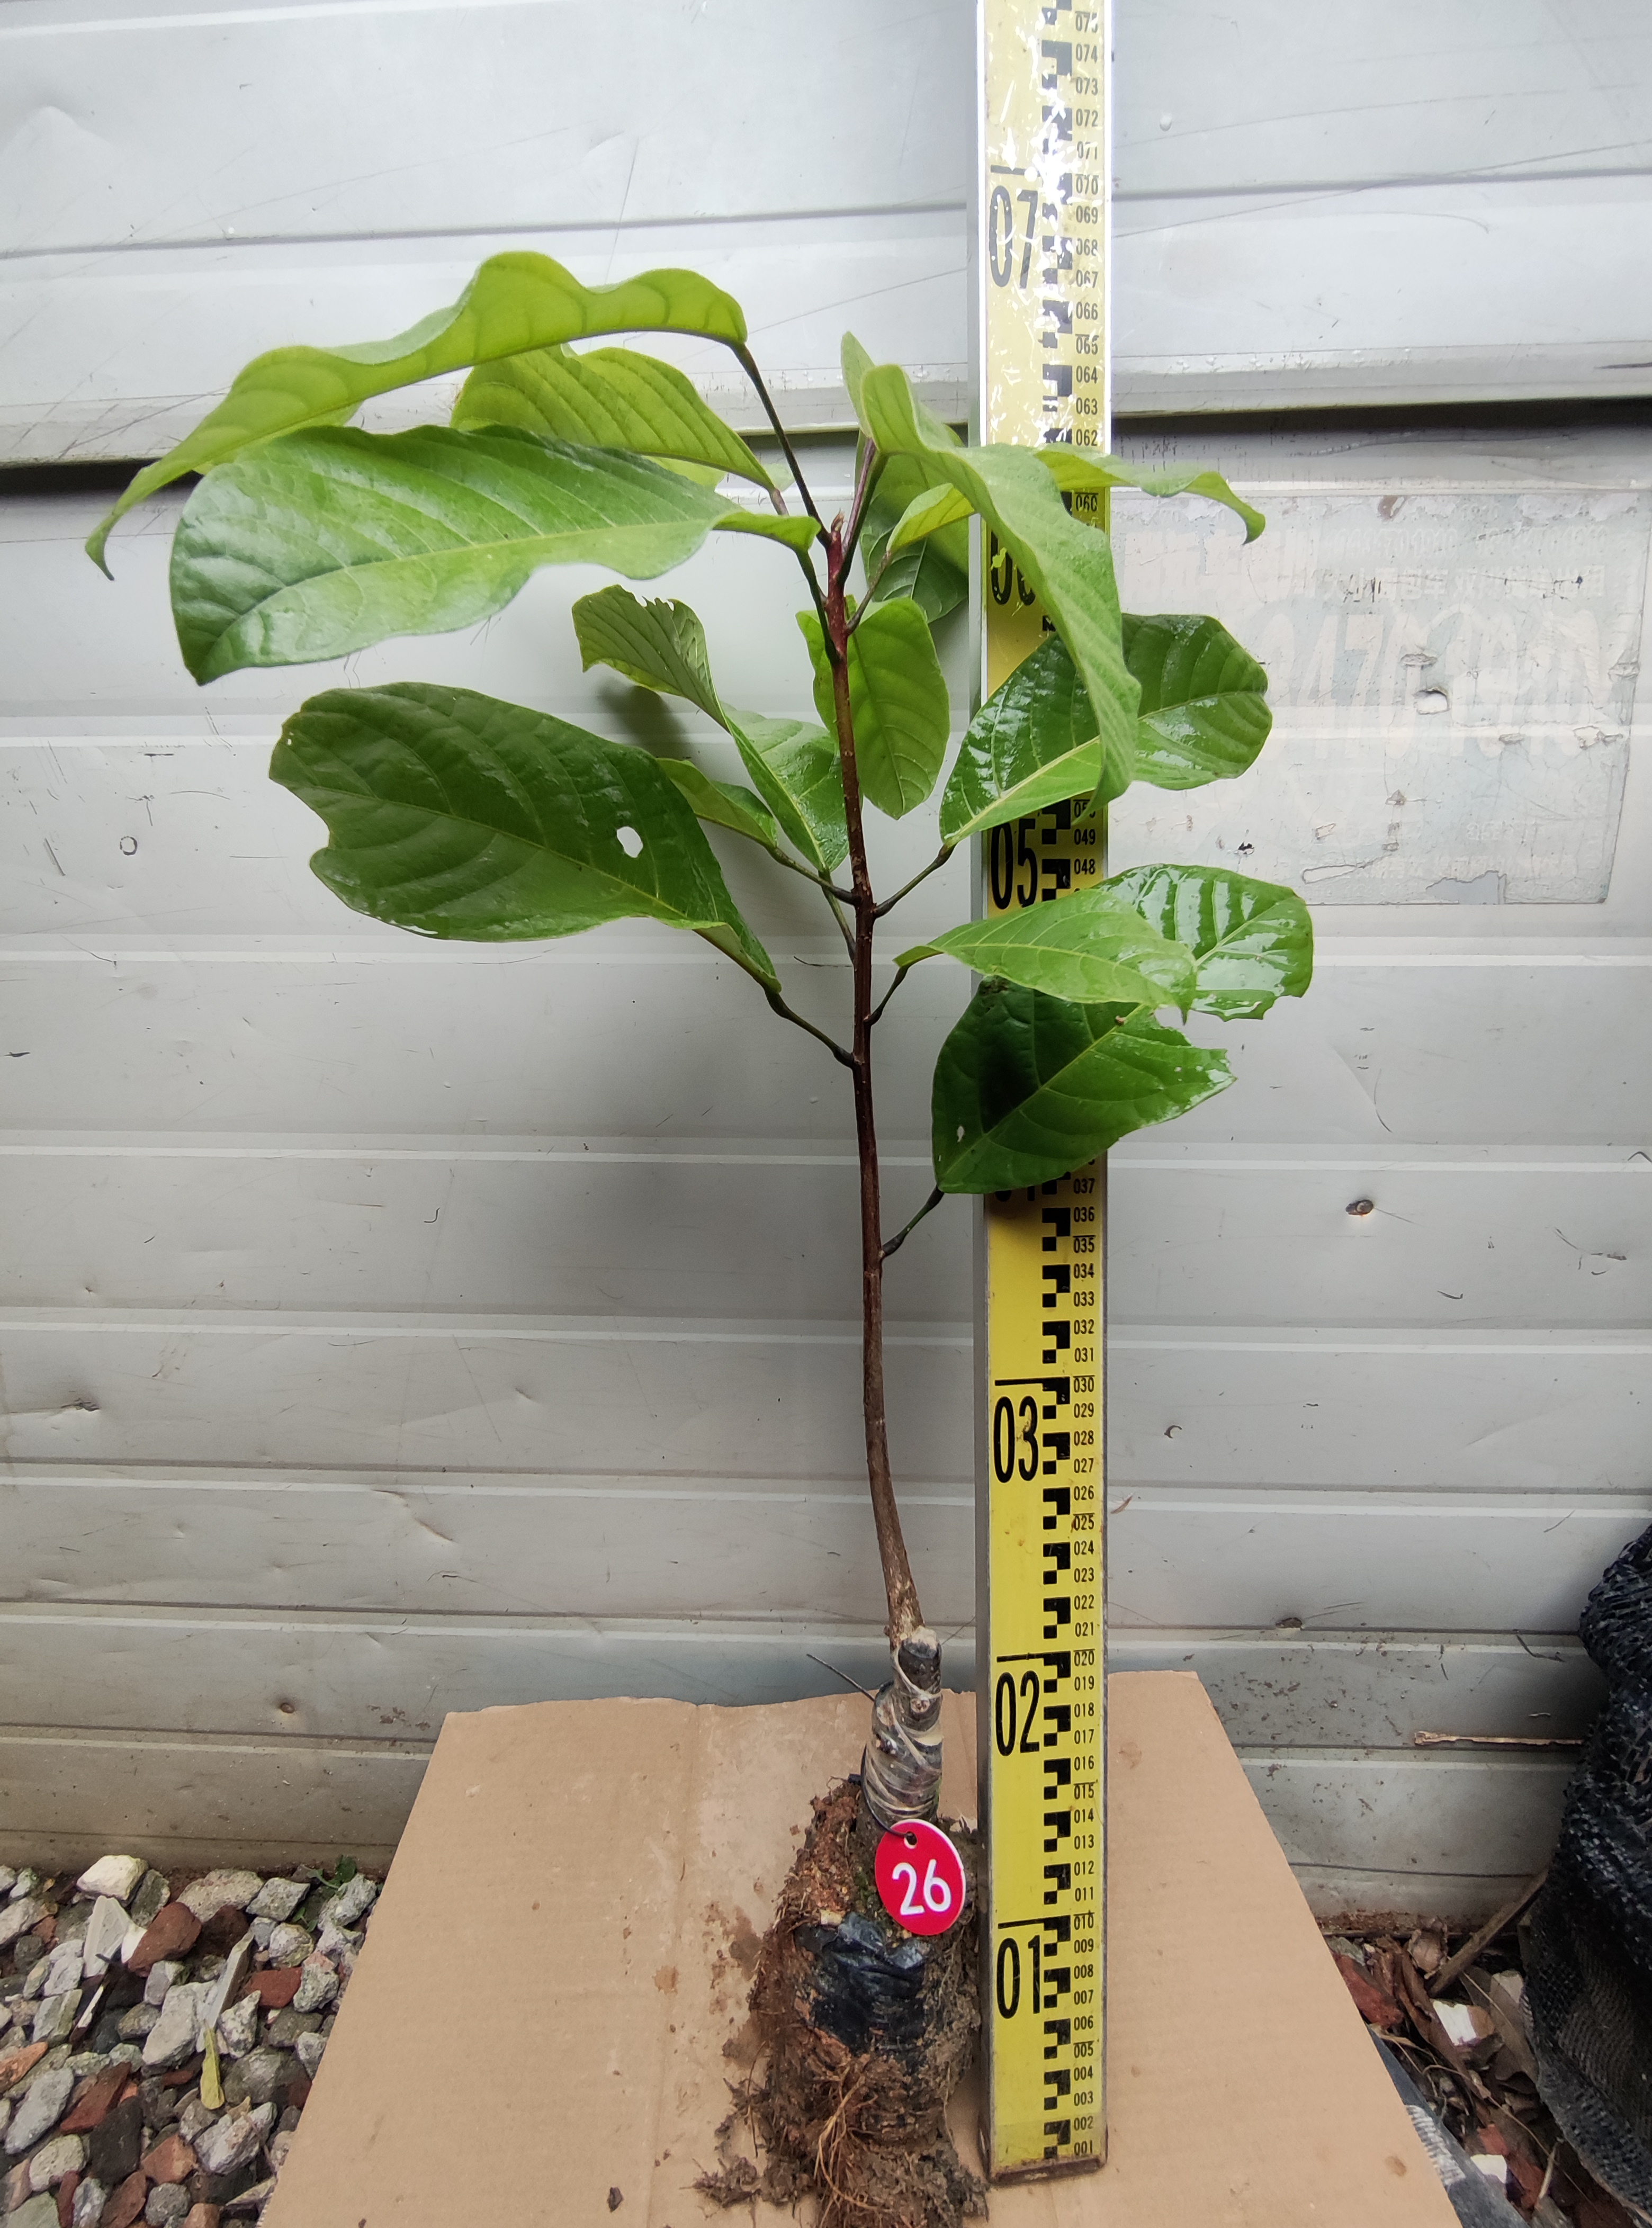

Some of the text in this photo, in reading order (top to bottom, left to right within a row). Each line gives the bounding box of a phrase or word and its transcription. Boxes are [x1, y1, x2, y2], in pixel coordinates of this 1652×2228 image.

[1075, 44, 1098, 62] 074
[1075, 77, 1098, 95] 073
[1075, 110, 1098, 127] 072
[1075, 177, 1098, 195] 070
[1075, 206, 1098, 224] 069
[989, 185, 1038, 290] 07
[1076, 238, 1098, 256] 068
[1076, 271, 1098, 289] 067
[1076, 303, 1098, 320] 066
[1076, 337, 1098, 355] 065
[1076, 366, 1098, 383] 064
[1076, 398, 1098, 415] 063
[1076, 429, 1098, 446] 062
[1074, 829, 1096, 846] 049
[991, 818, 1038, 910] 05
[1074, 859, 1096, 875] 048
[1073, 1178, 1095, 1194] 037
[1073, 1207, 1095, 1223] 036
[1073, 1238, 1095, 1253] 035
[1073, 1263, 1094, 1279] 034
[1073, 1292, 1094, 1307] 033
[1073, 1319, 1094, 1334] 032
[1074, 1347, 1094, 1362] 031
[1073, 1378, 1094, 1392] 030
[1073, 1404, 1094, 1418] 029
[994, 1395, 1038, 1484] 03
[1073, 1431, 1094, 1445] 028
[1073, 1458, 1094, 1474] 027
[1073, 1486, 1094, 1501] 026
[1073, 1515, 1094, 1531] 025
[1073, 1541, 1094, 1556] 024
[1073, 1568, 1094, 1583] 023
[1074, 1595, 1094, 1610] 022
[1075, 1622, 1094, 1637] 021
[1074, 1651, 1094, 1666] 020
[1074, 1676, 1094, 1691] 019
[995, 1670, 1039, 1756] 02
[1074, 1703, 1094, 1718] 018
[1074, 1729, 1094, 1745] 017
[1074, 1756, 1094, 1771] 016
[1074, 1784, 1094, 1799] 015
[1074, 1809, 1094, 1823] 014
[1074, 1835, 1094, 1850] 013
[1074, 1861, 1094, 1876] 012
[892, 1859, 951, 1916] 26
[1075, 1886, 1094, 1901] 011
[1074, 1915, 1094, 1929] 010
[1074, 1938, 1094, 1954] 009
[996, 1935, 1041, 2019] 01
[1074, 1964, 1094, 1979] 008
[1074, 1989, 1094, 2005] 007
[1074, 2015, 1094, 2030] 006
[1074, 2044, 1094, 2058] 005
[1074, 2065, 1093, 2080] 004
[1074, 2091, 1094, 2106] 003
[1074, 2116, 1093, 2131] 002
[1074, 2141, 1093, 2156] 001
